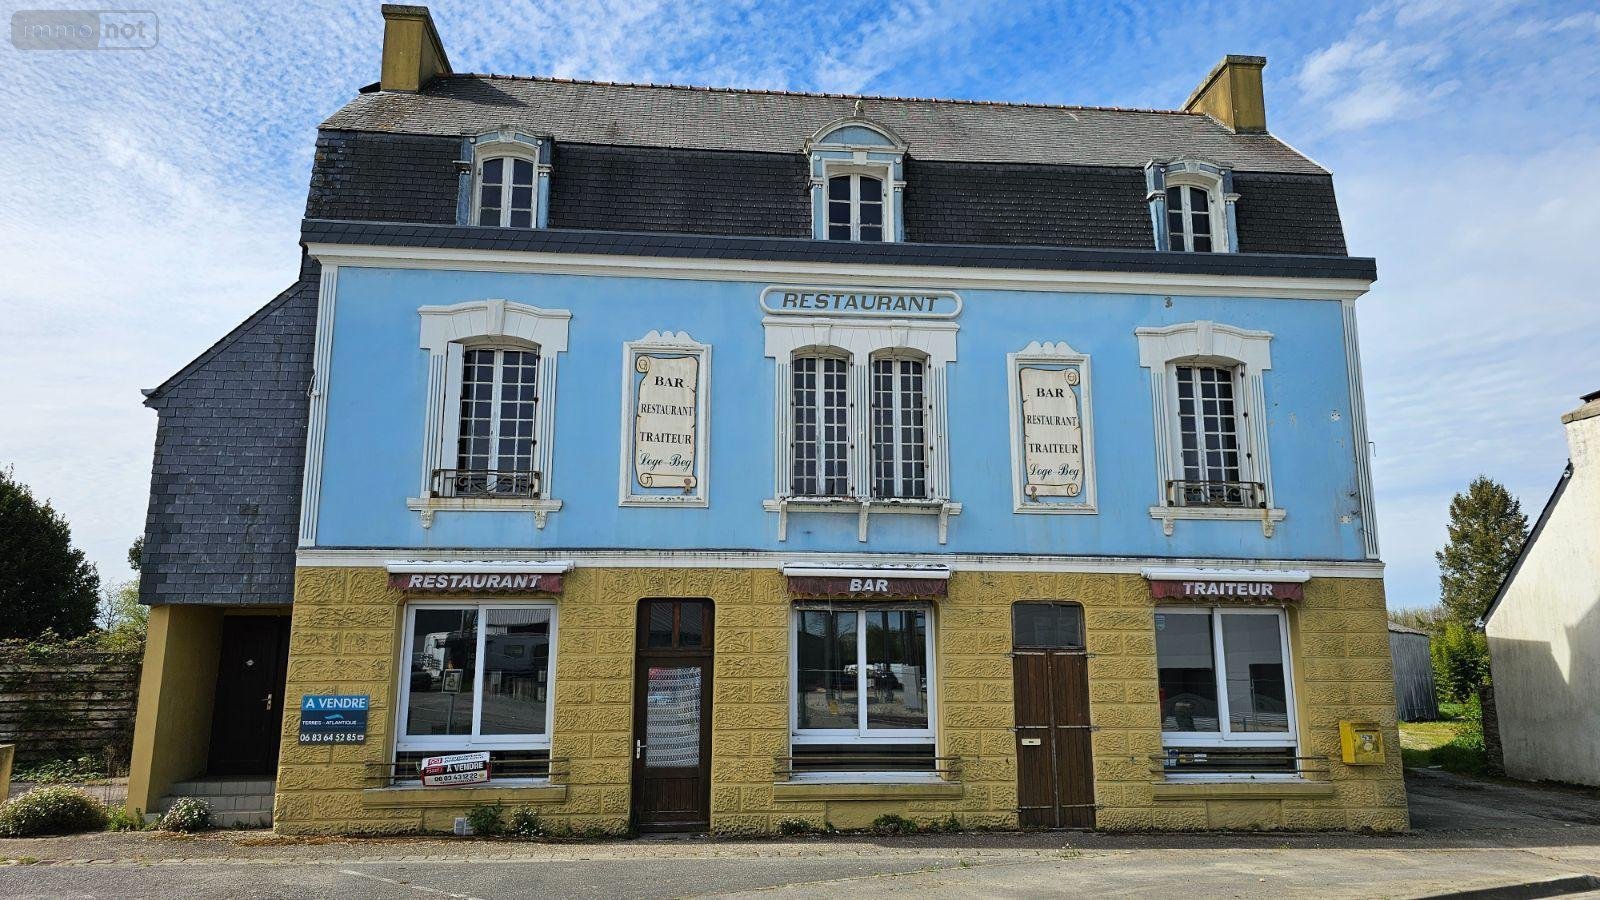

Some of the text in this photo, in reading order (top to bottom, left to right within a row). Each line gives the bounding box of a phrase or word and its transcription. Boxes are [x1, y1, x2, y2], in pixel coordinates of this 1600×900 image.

[782, 292, 939, 312] RESTAURANT
[654, 376, 684, 388] BAR
[1037, 387, 1064, 398] BAR
[641, 403, 694, 416] RESTAURANT
[1026, 415, 1077, 426] RESTAURANT
[639, 431, 692, 445] TRAITEUR
[1028, 443, 1079, 454] TRAITEUR
[408, 574, 542, 588] RESTAURANT
[849, 578, 889, 592] BAR
[1182, 582, 1273, 596] TRAITEUR
[305, 698, 366, 709] A VENDRE
[300, 733, 356, 742] 06 83 64 52 85
[454, 762, 484, 772] VENDRE
